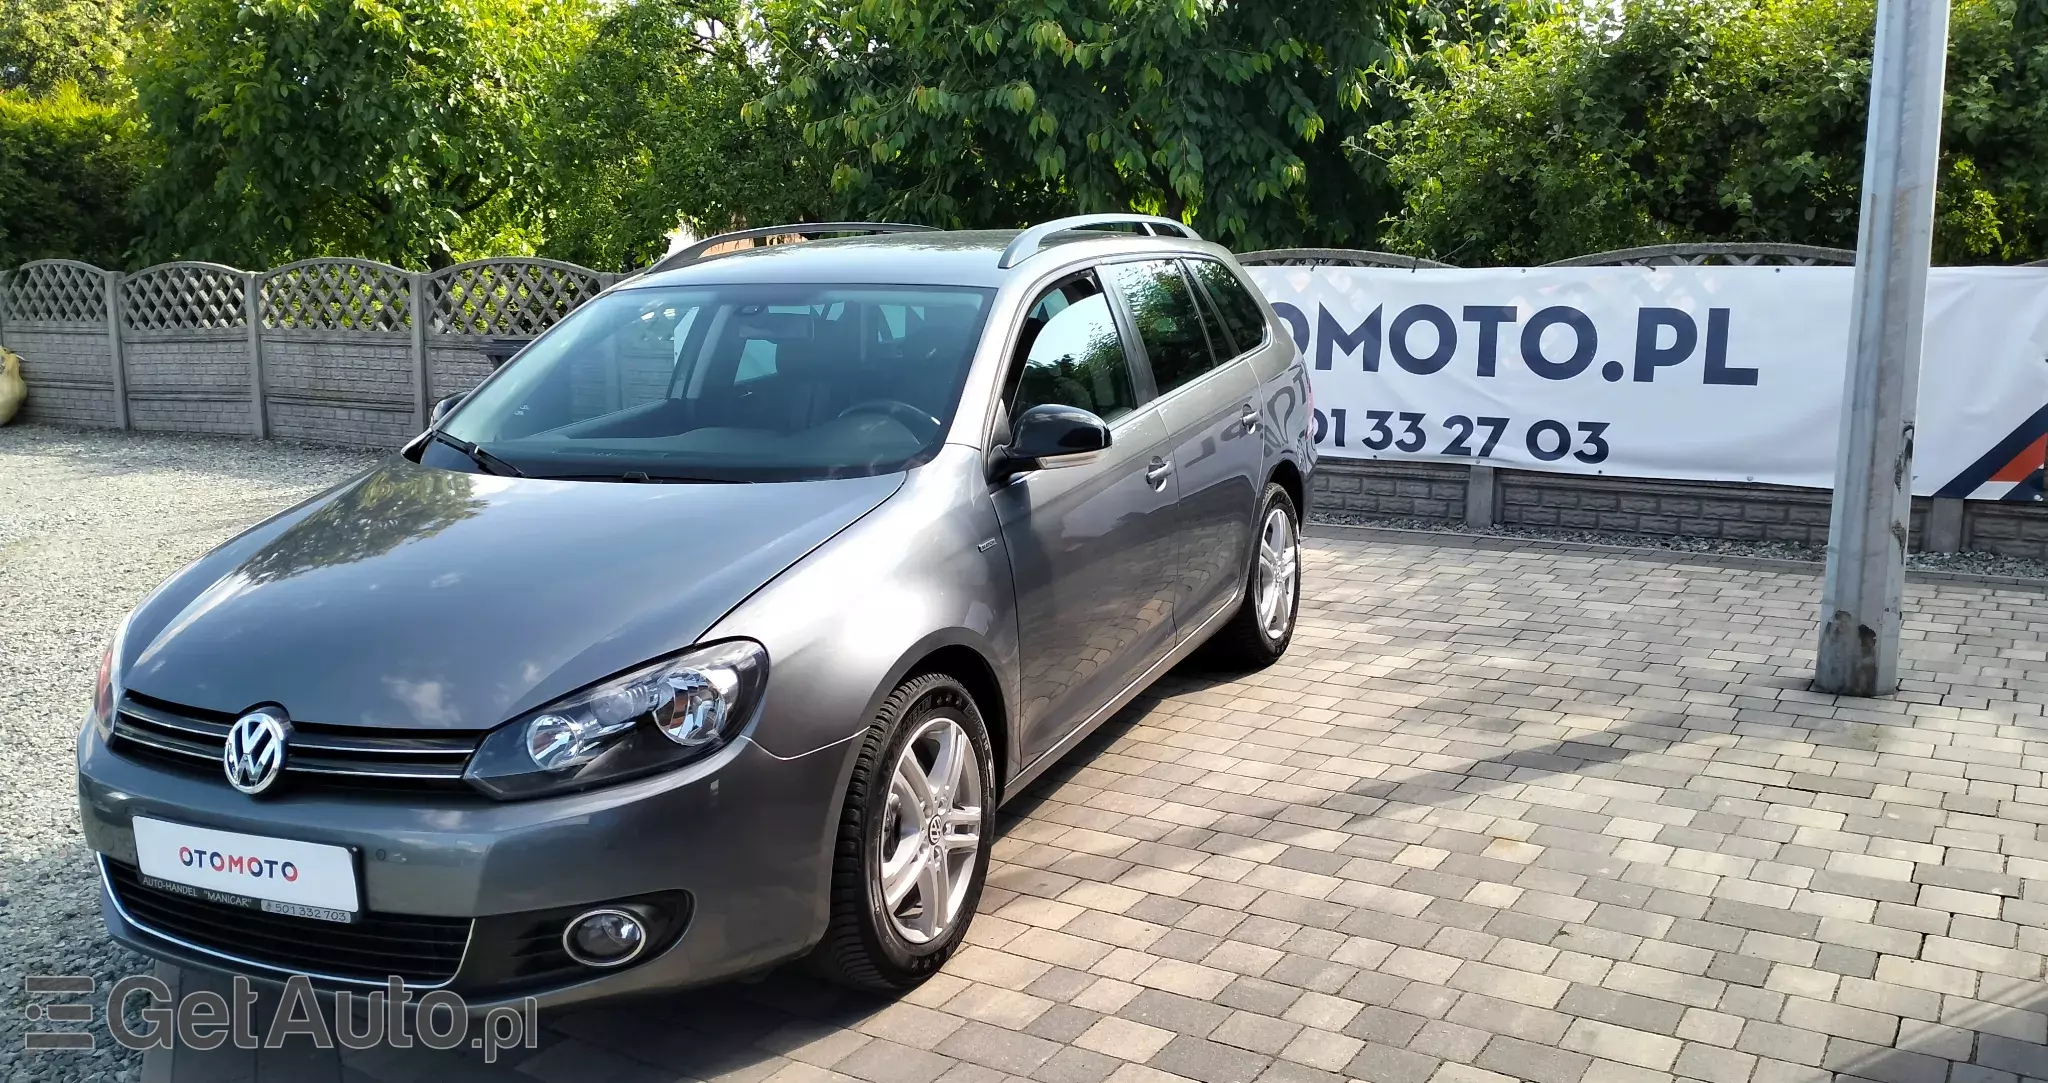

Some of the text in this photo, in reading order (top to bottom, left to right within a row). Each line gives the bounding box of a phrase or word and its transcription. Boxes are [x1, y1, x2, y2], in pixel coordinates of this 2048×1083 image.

[1361, 410, 1427, 453] 33
[1440, 414, 1510, 457] 27
[1525, 419, 1611, 464] 03
[224, 712, 283, 795] VW
[178, 845, 299, 883] OTOMOTO
[142, 876, 347, 922] AUTO-HANDEL "MANICAR" 501 332 703
